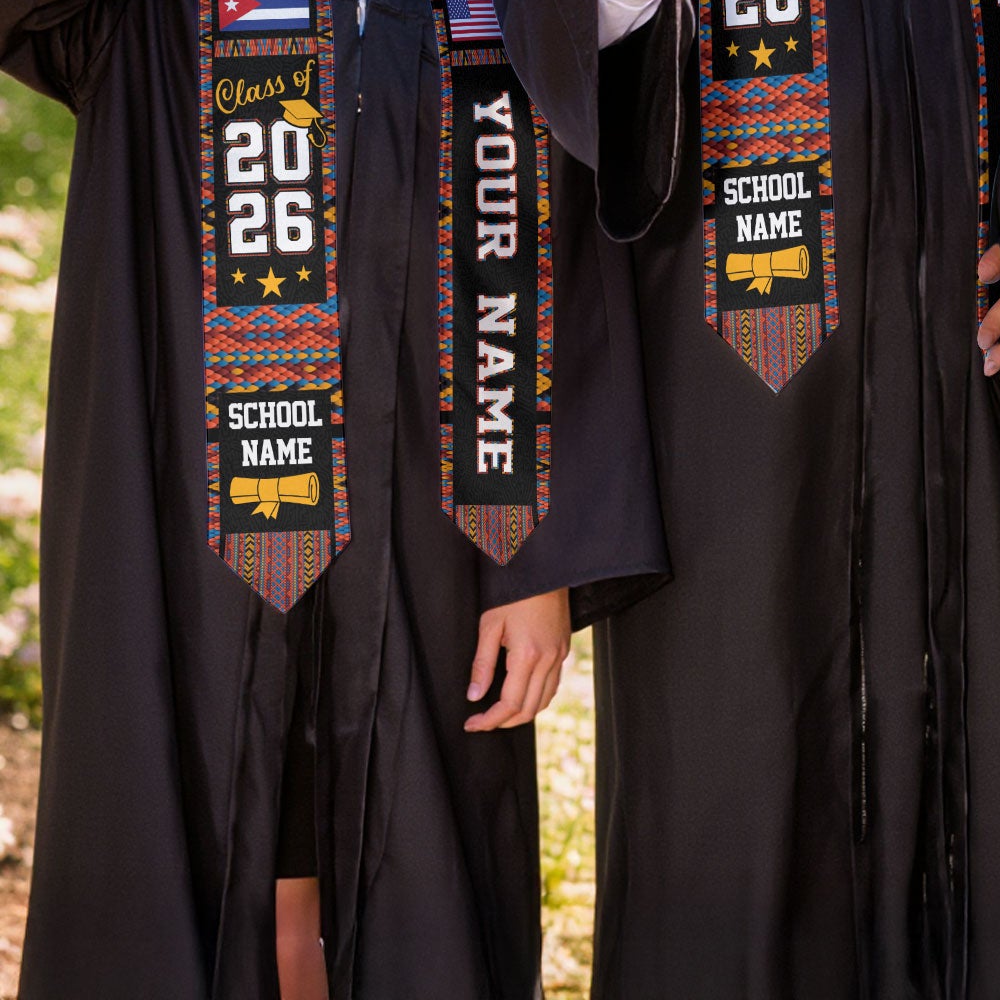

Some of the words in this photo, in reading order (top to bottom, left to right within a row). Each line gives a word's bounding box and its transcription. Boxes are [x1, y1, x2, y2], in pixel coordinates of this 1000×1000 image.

[215, 75, 285, 114] Class
[292, 59, 316, 96] of
[222, 117, 314, 186] 20
[473, 91, 518, 261] YOUR
[723, 171, 812, 206] SCHOOL
[226, 188, 316, 257] 26
[736, 209, 803, 243] NAME
[476, 292, 517, 475] NAME
[228, 399, 323, 430] SCHOOL
[241, 437, 313, 467] NAME
